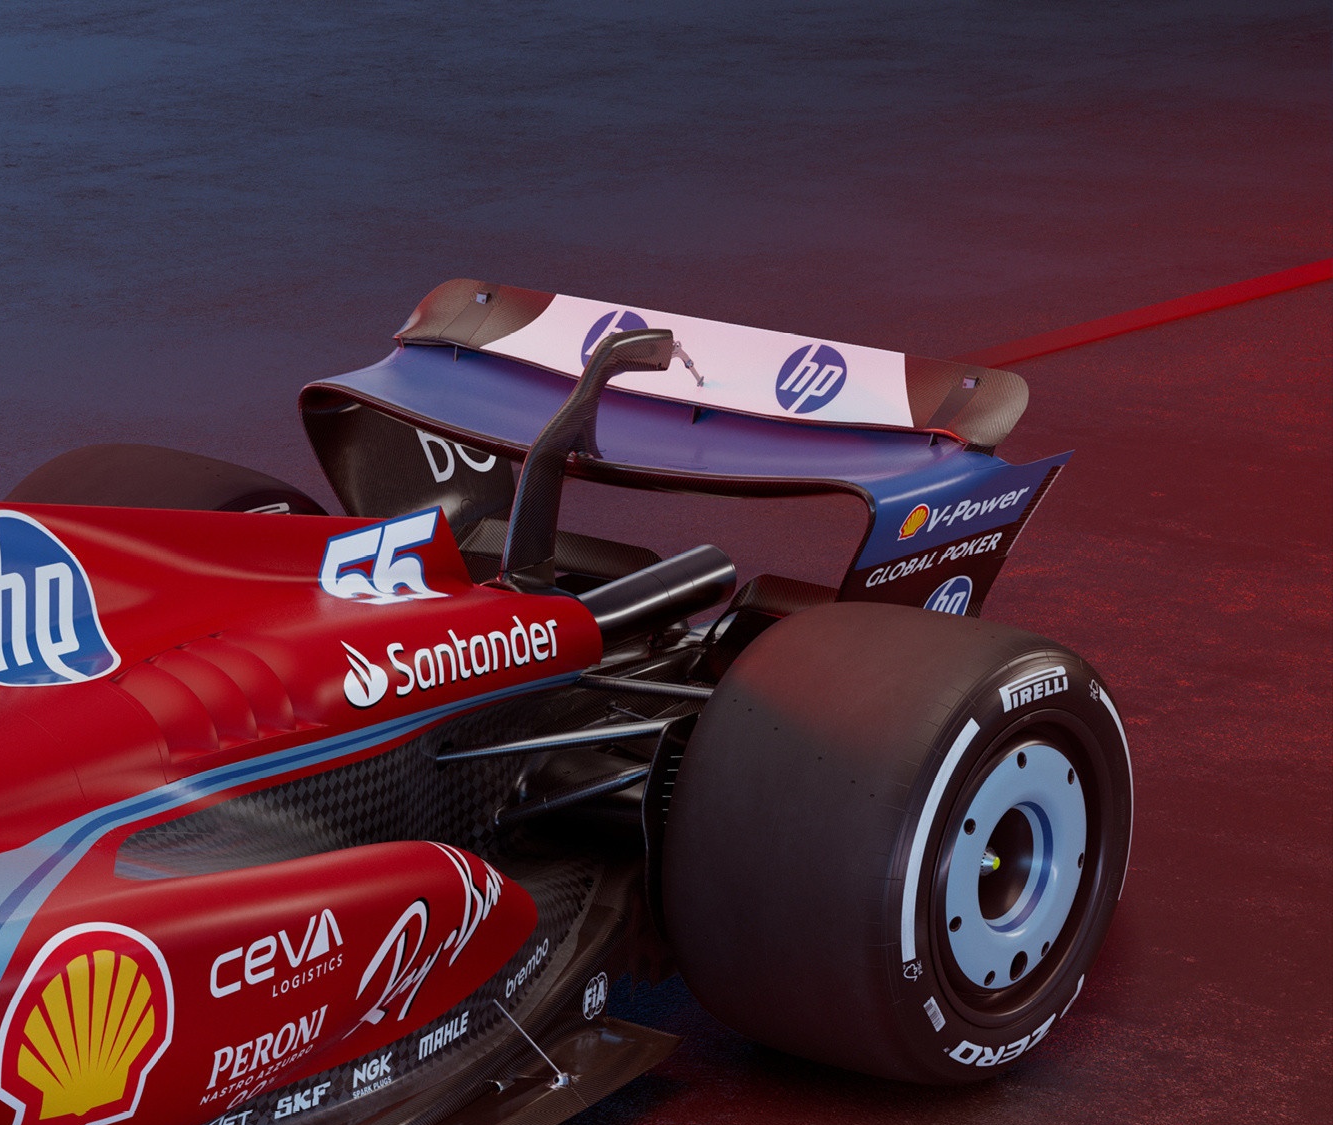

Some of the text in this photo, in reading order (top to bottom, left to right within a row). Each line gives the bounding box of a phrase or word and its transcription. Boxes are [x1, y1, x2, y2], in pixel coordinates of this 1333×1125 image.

[781, 344, 844, 414] hp
[927, 486, 1030, 533] V-Power
[320, 506, 451, 604] 55
[865, 532, 1003, 588] GLOBAL POKER
[386, 615, 557, 696] Santander
[999, 666, 1068, 713] PIRELLI
[272, 953, 344, 998] LOGISTICS
[505, 938, 549, 999] brembo
[206, 1004, 329, 1090] PERONI
[418, 1011, 469, 1060] MAHLE
[949, 1013, 1057, 1067] ZERO
[199, 1044, 314, 1106] NASTRO AZZURRO
[352, 1051, 392, 1088] NGK
[352, 1076, 393, 1099] SPARK PLUGS
[274, 1081, 331, 1120] SKF
